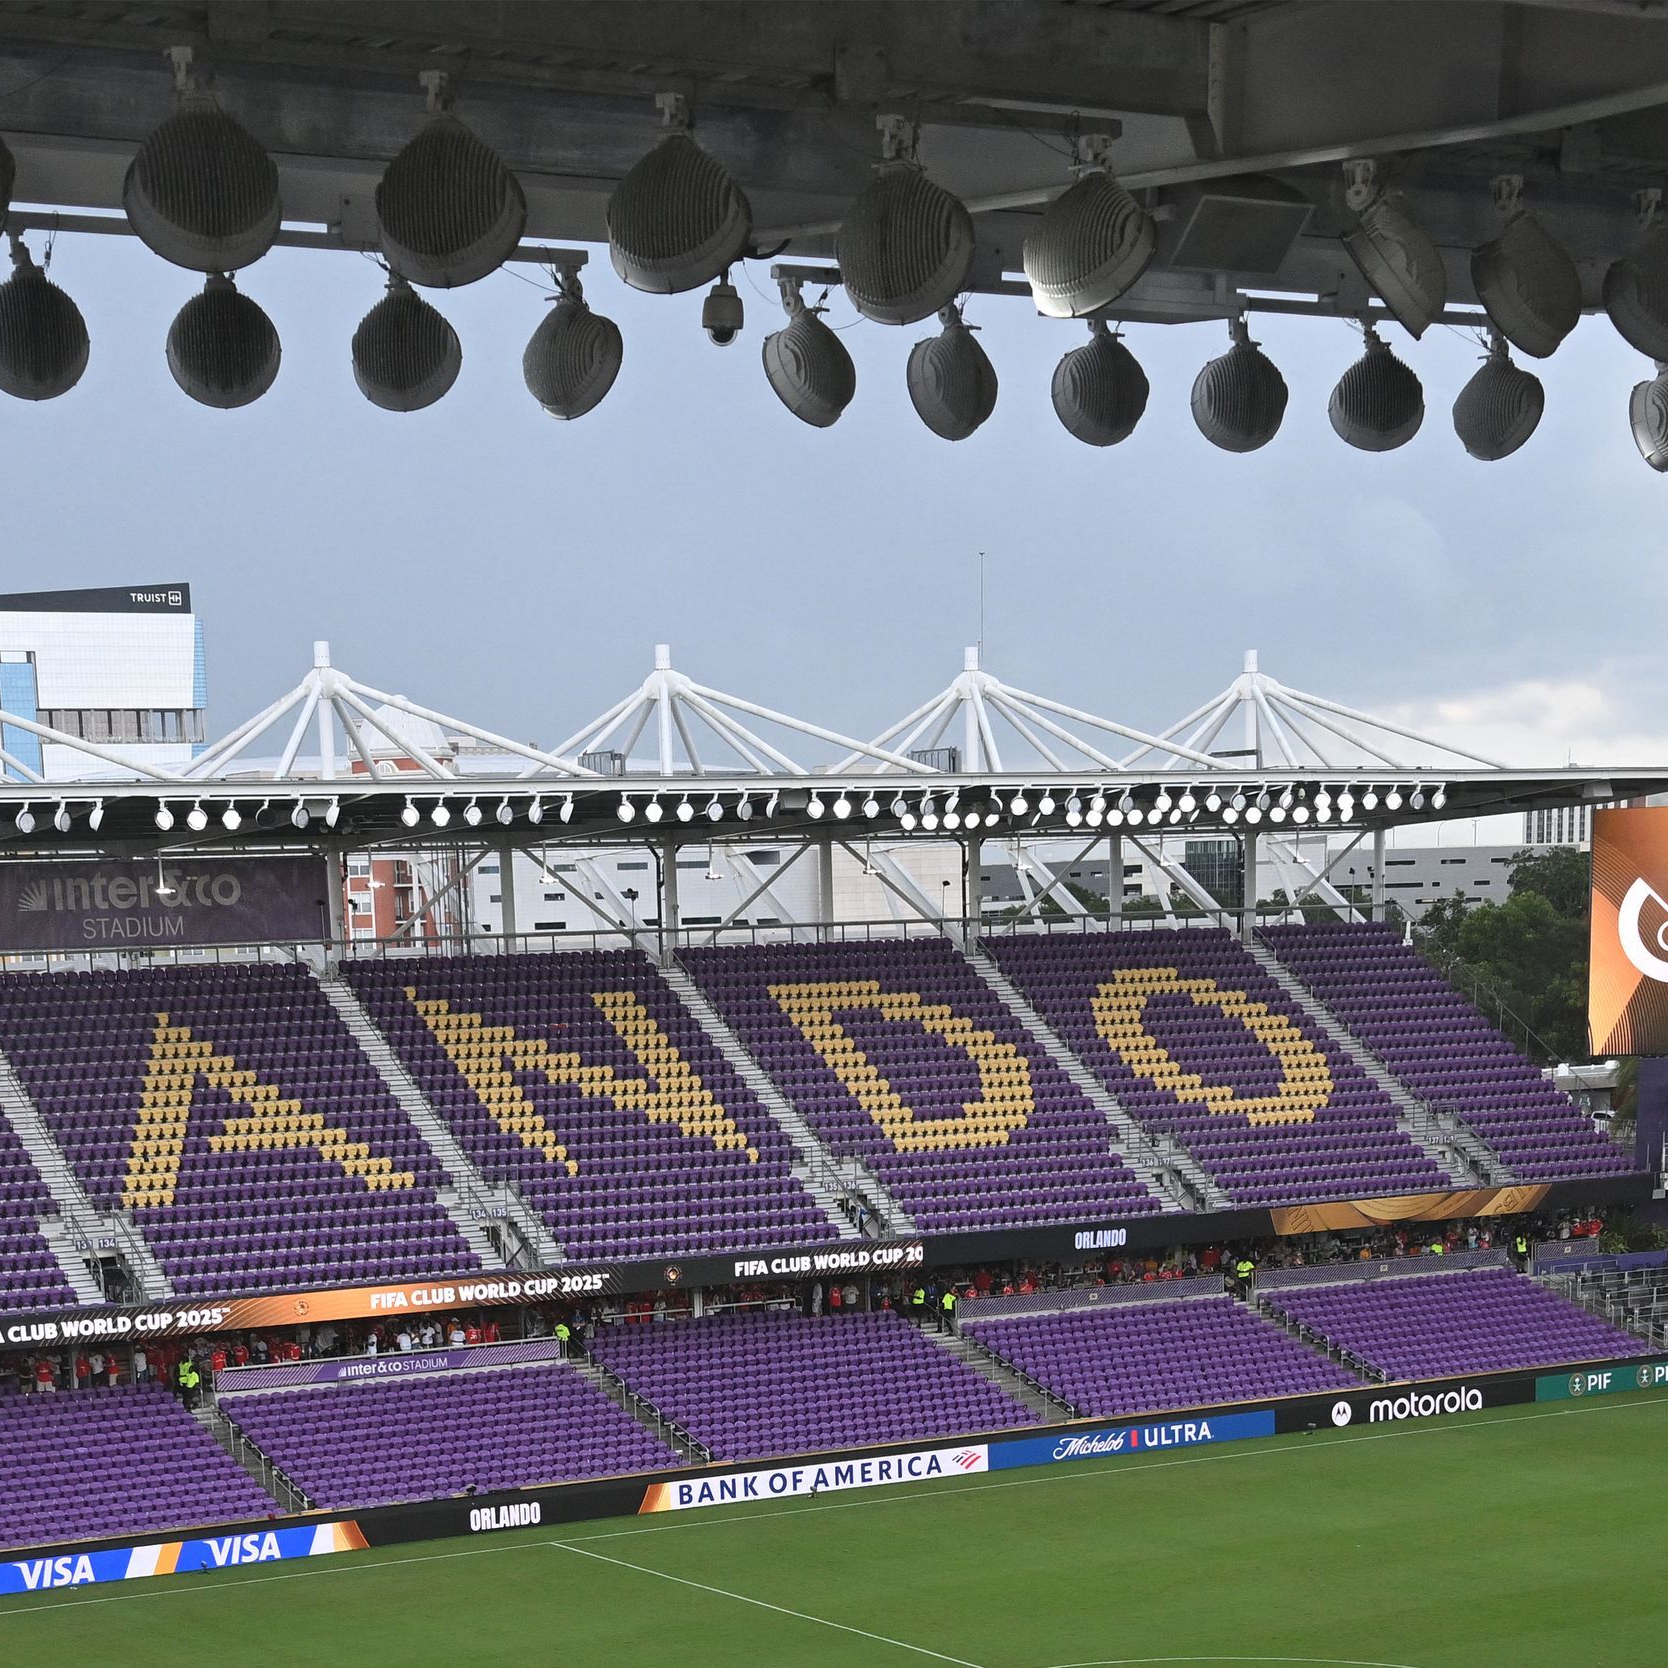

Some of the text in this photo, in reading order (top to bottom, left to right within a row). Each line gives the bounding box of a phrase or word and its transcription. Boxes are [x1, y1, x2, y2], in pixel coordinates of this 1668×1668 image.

[130, 593, 167, 603] TRUIST
[83, 916, 184, 940] STADIUM
[492, 1209, 507, 1217] 135
[99, 1239, 115, 1248] 134
[1074, 1228, 1127, 1250] ORLANDO
[734, 1259, 768, 1277] FIFA
[771, 1255, 812, 1274] CLUB
[814, 1249, 870, 1270] WORLD
[872, 1247, 903, 1266] CUP
[370, 1292, 408, 1310] FIFA
[411, 1287, 455, 1306] CLUB
[458, 1282, 522, 1302] WORLD
[524, 1278, 558, 1296] CUP
[8, 1322, 58, 1343] CLUB
[61, 1316, 132, 1337] WORLD
[134, 1313, 173, 1331] CUP
[403, 1356, 448, 1373] STADIUM
[1587, 1372, 1612, 1390] PIF
[1369, 1386, 1483, 1422] motorola
[1052, 1421, 1215, 1461] Michelob ULTRA
[678, 1454, 943, 1507] BANK OF AMERICA
[469, 1502, 542, 1533] ORLANDO
[204, 1532, 281, 1566] VISA
[13, 1555, 95, 1591] VISA
